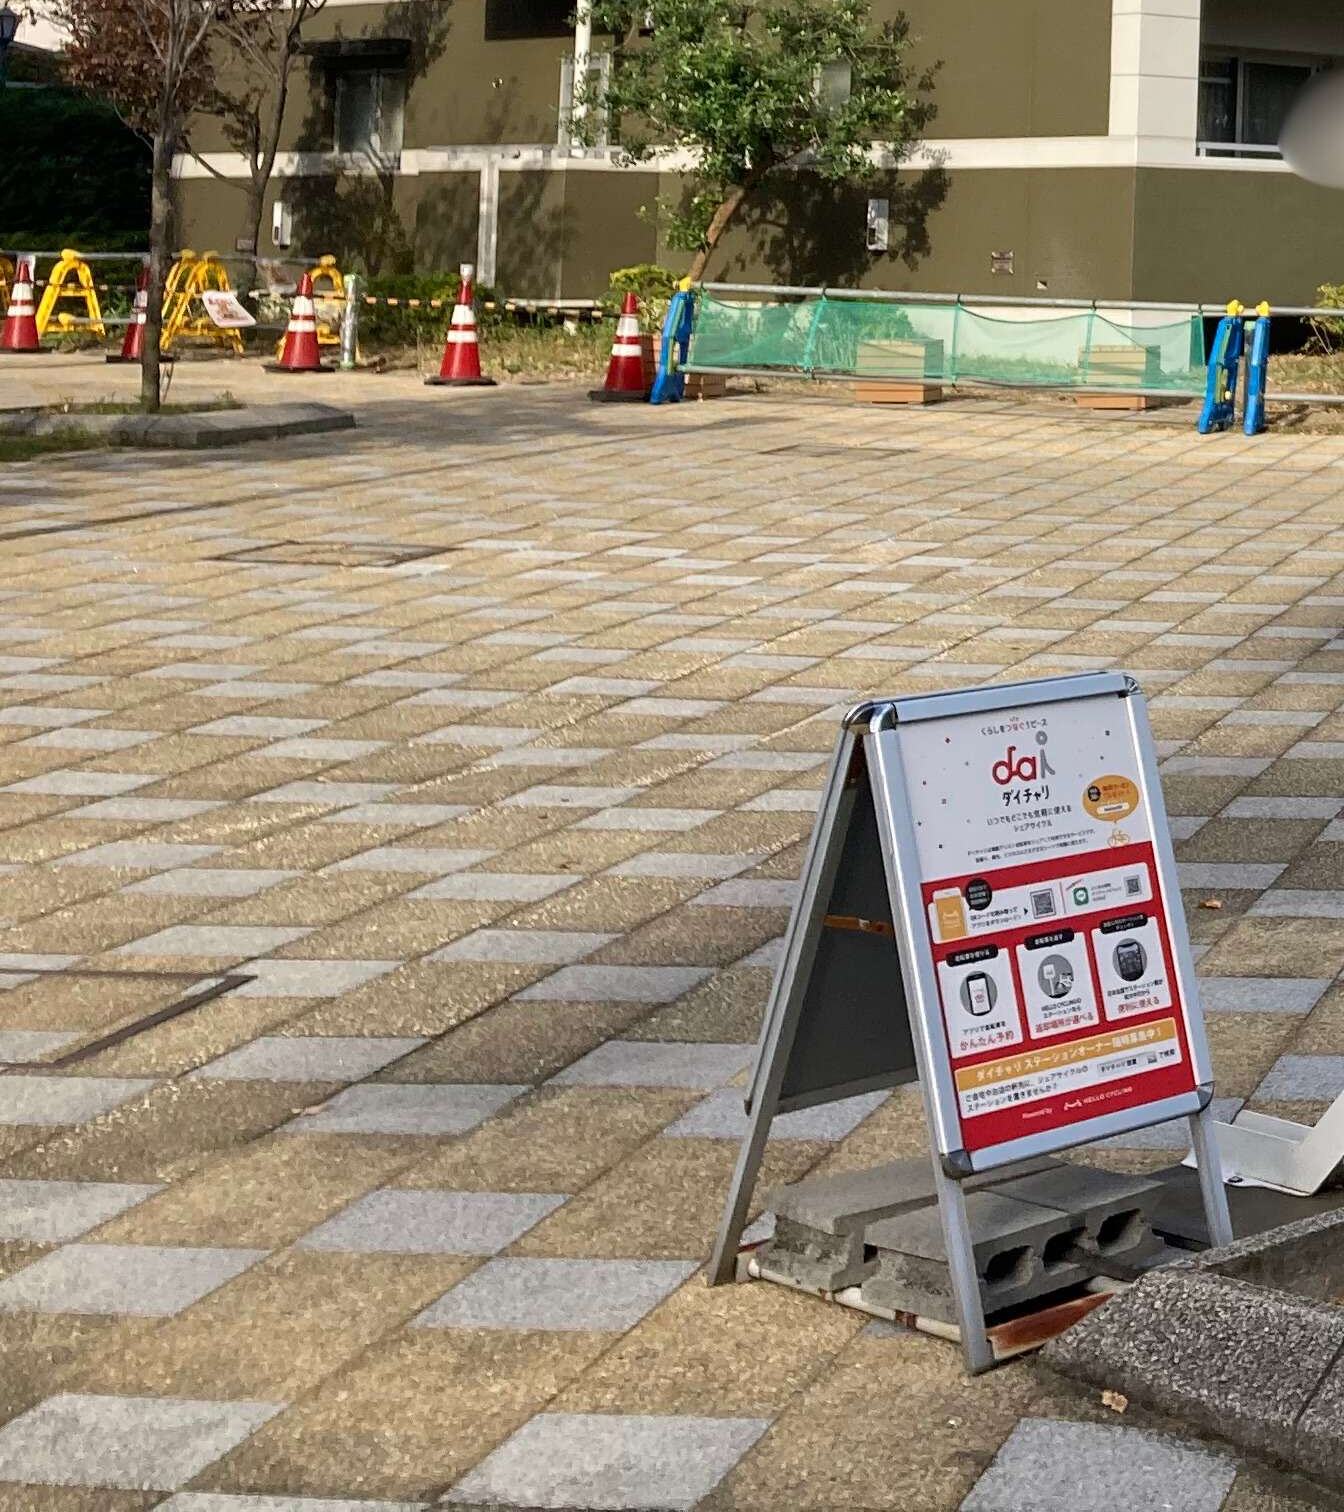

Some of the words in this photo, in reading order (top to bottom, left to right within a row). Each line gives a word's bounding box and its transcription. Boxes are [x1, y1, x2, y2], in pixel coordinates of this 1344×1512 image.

[1002, 785, 1050, 807] ダイチャリ
[986, 804, 1072, 826] いつでもどこでも気軽に使える
[960, 1030, 1014, 1050] かんたん予約
[976, 1061, 1021, 1081] ダイチャリ
